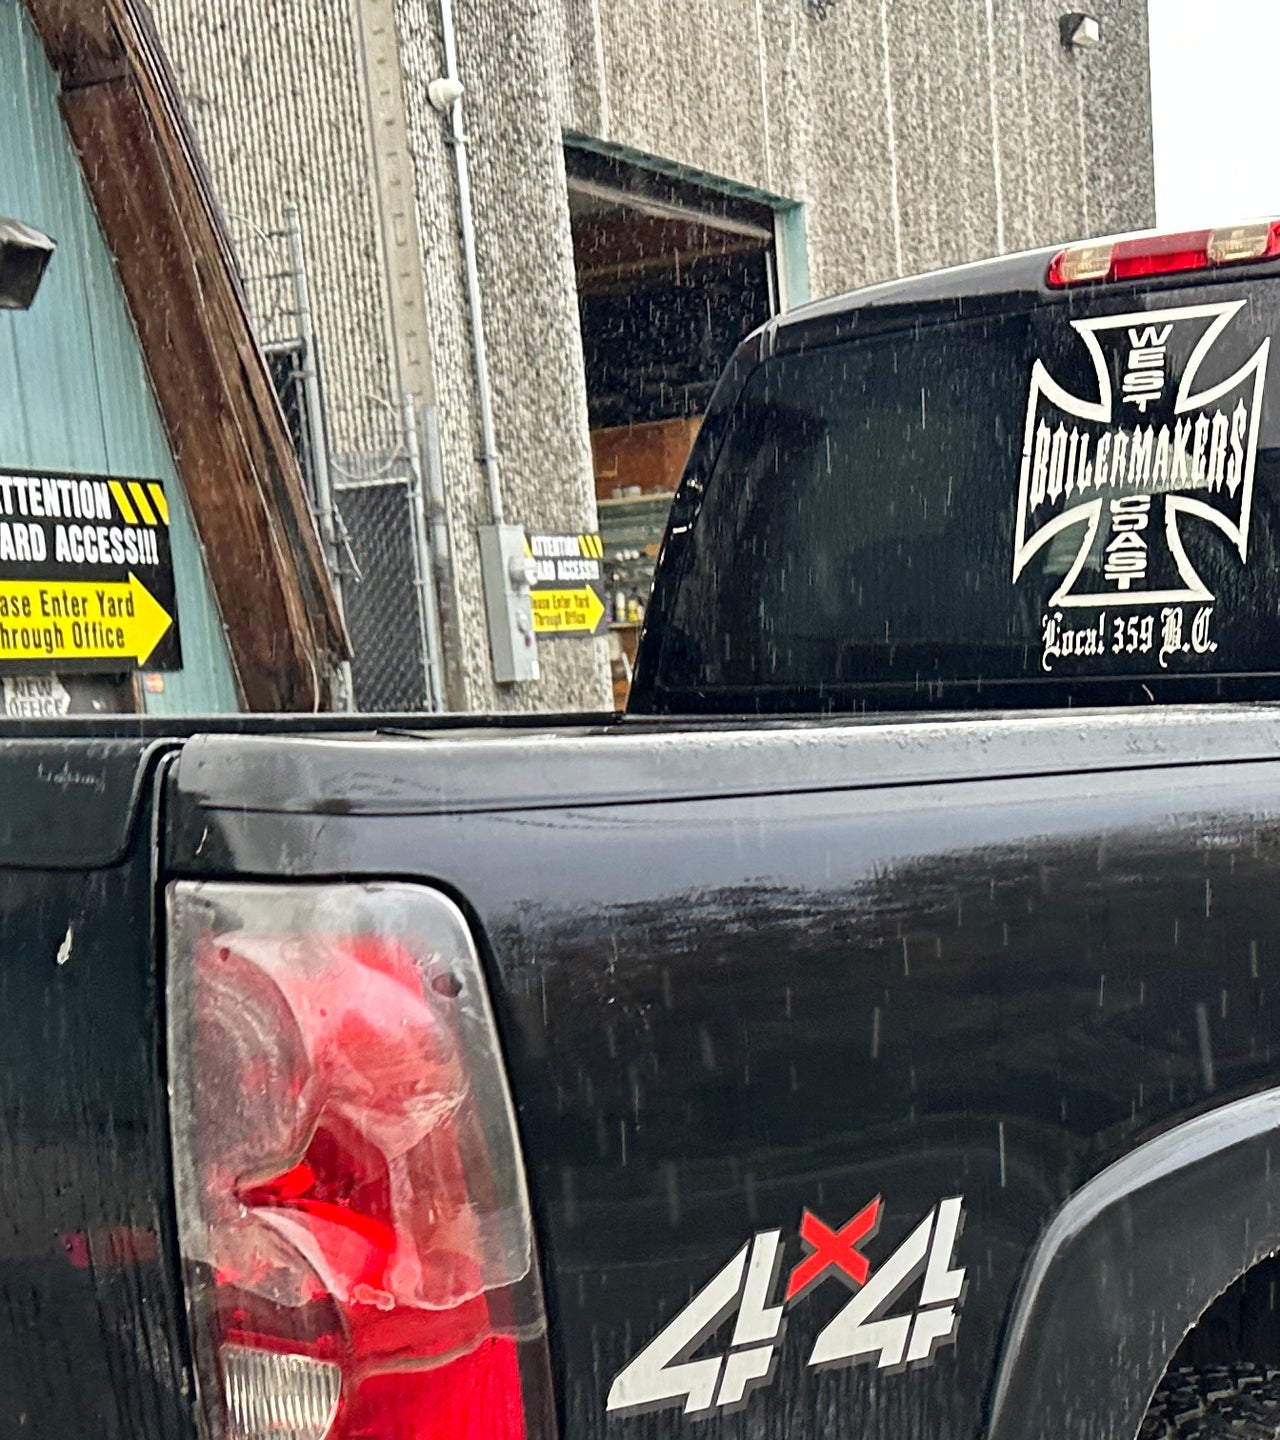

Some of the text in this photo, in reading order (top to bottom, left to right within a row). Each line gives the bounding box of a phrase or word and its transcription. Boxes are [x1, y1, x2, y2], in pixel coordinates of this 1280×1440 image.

[1122, 324, 1174, 413] WEST
[1031, 398, 1248, 513] BOILERMAKERS
[55, 525, 160, 565] ACCESS!!!
[531, 536, 580, 556] ATTENTION
[1105, 495, 1151, 590] COAST
[41, 589, 89, 618] Enter
[96, 591, 135, 618] Yard
[73, 624, 125, 650] Office
[1042, 607, 1218, 671] Local 359 B.C.
